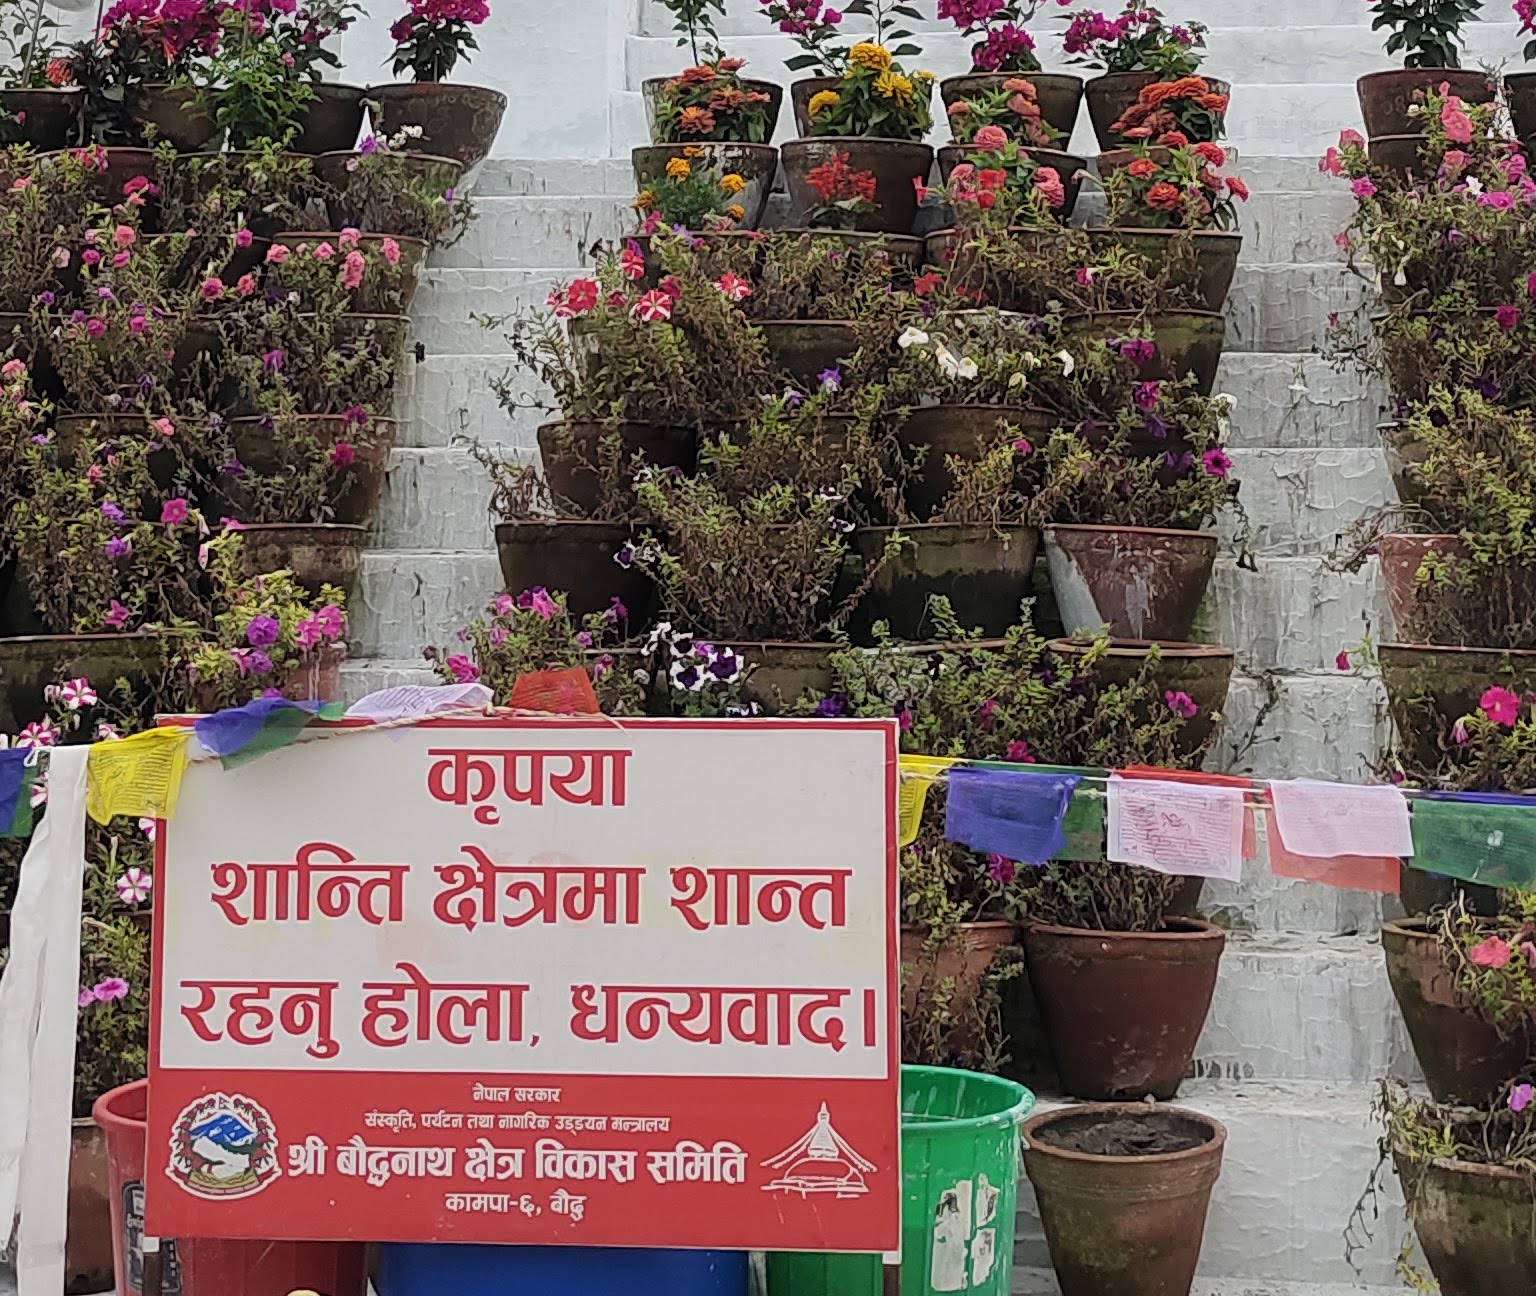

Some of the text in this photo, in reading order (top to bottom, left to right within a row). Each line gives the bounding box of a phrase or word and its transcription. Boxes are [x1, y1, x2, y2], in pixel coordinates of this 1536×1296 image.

[428, 749, 632, 825] कृपया
[211, 842, 853, 931] शान्ति क्षेत्रमा शान्त
[180, 961, 876, 1058] रहनु होला, धन्यवाद।
[364, 1109, 417, 1133] संस्कृति,
[421, 1110, 464, 1128] पर्यटन
[467, 1114, 495, 1129] तथा
[498, 1110, 551, 1130] नागरिक
[611, 1116, 671, 1132] मन्त्रालय
[472, 1082, 562, 1103] नेपाल सरकार
[288, 1136, 329, 1177] श्री
[464, 1138, 526, 1182] क्षेत्र
[535, 1138, 639, 1182] विकास
[646, 1140, 749, 1184] समिति
